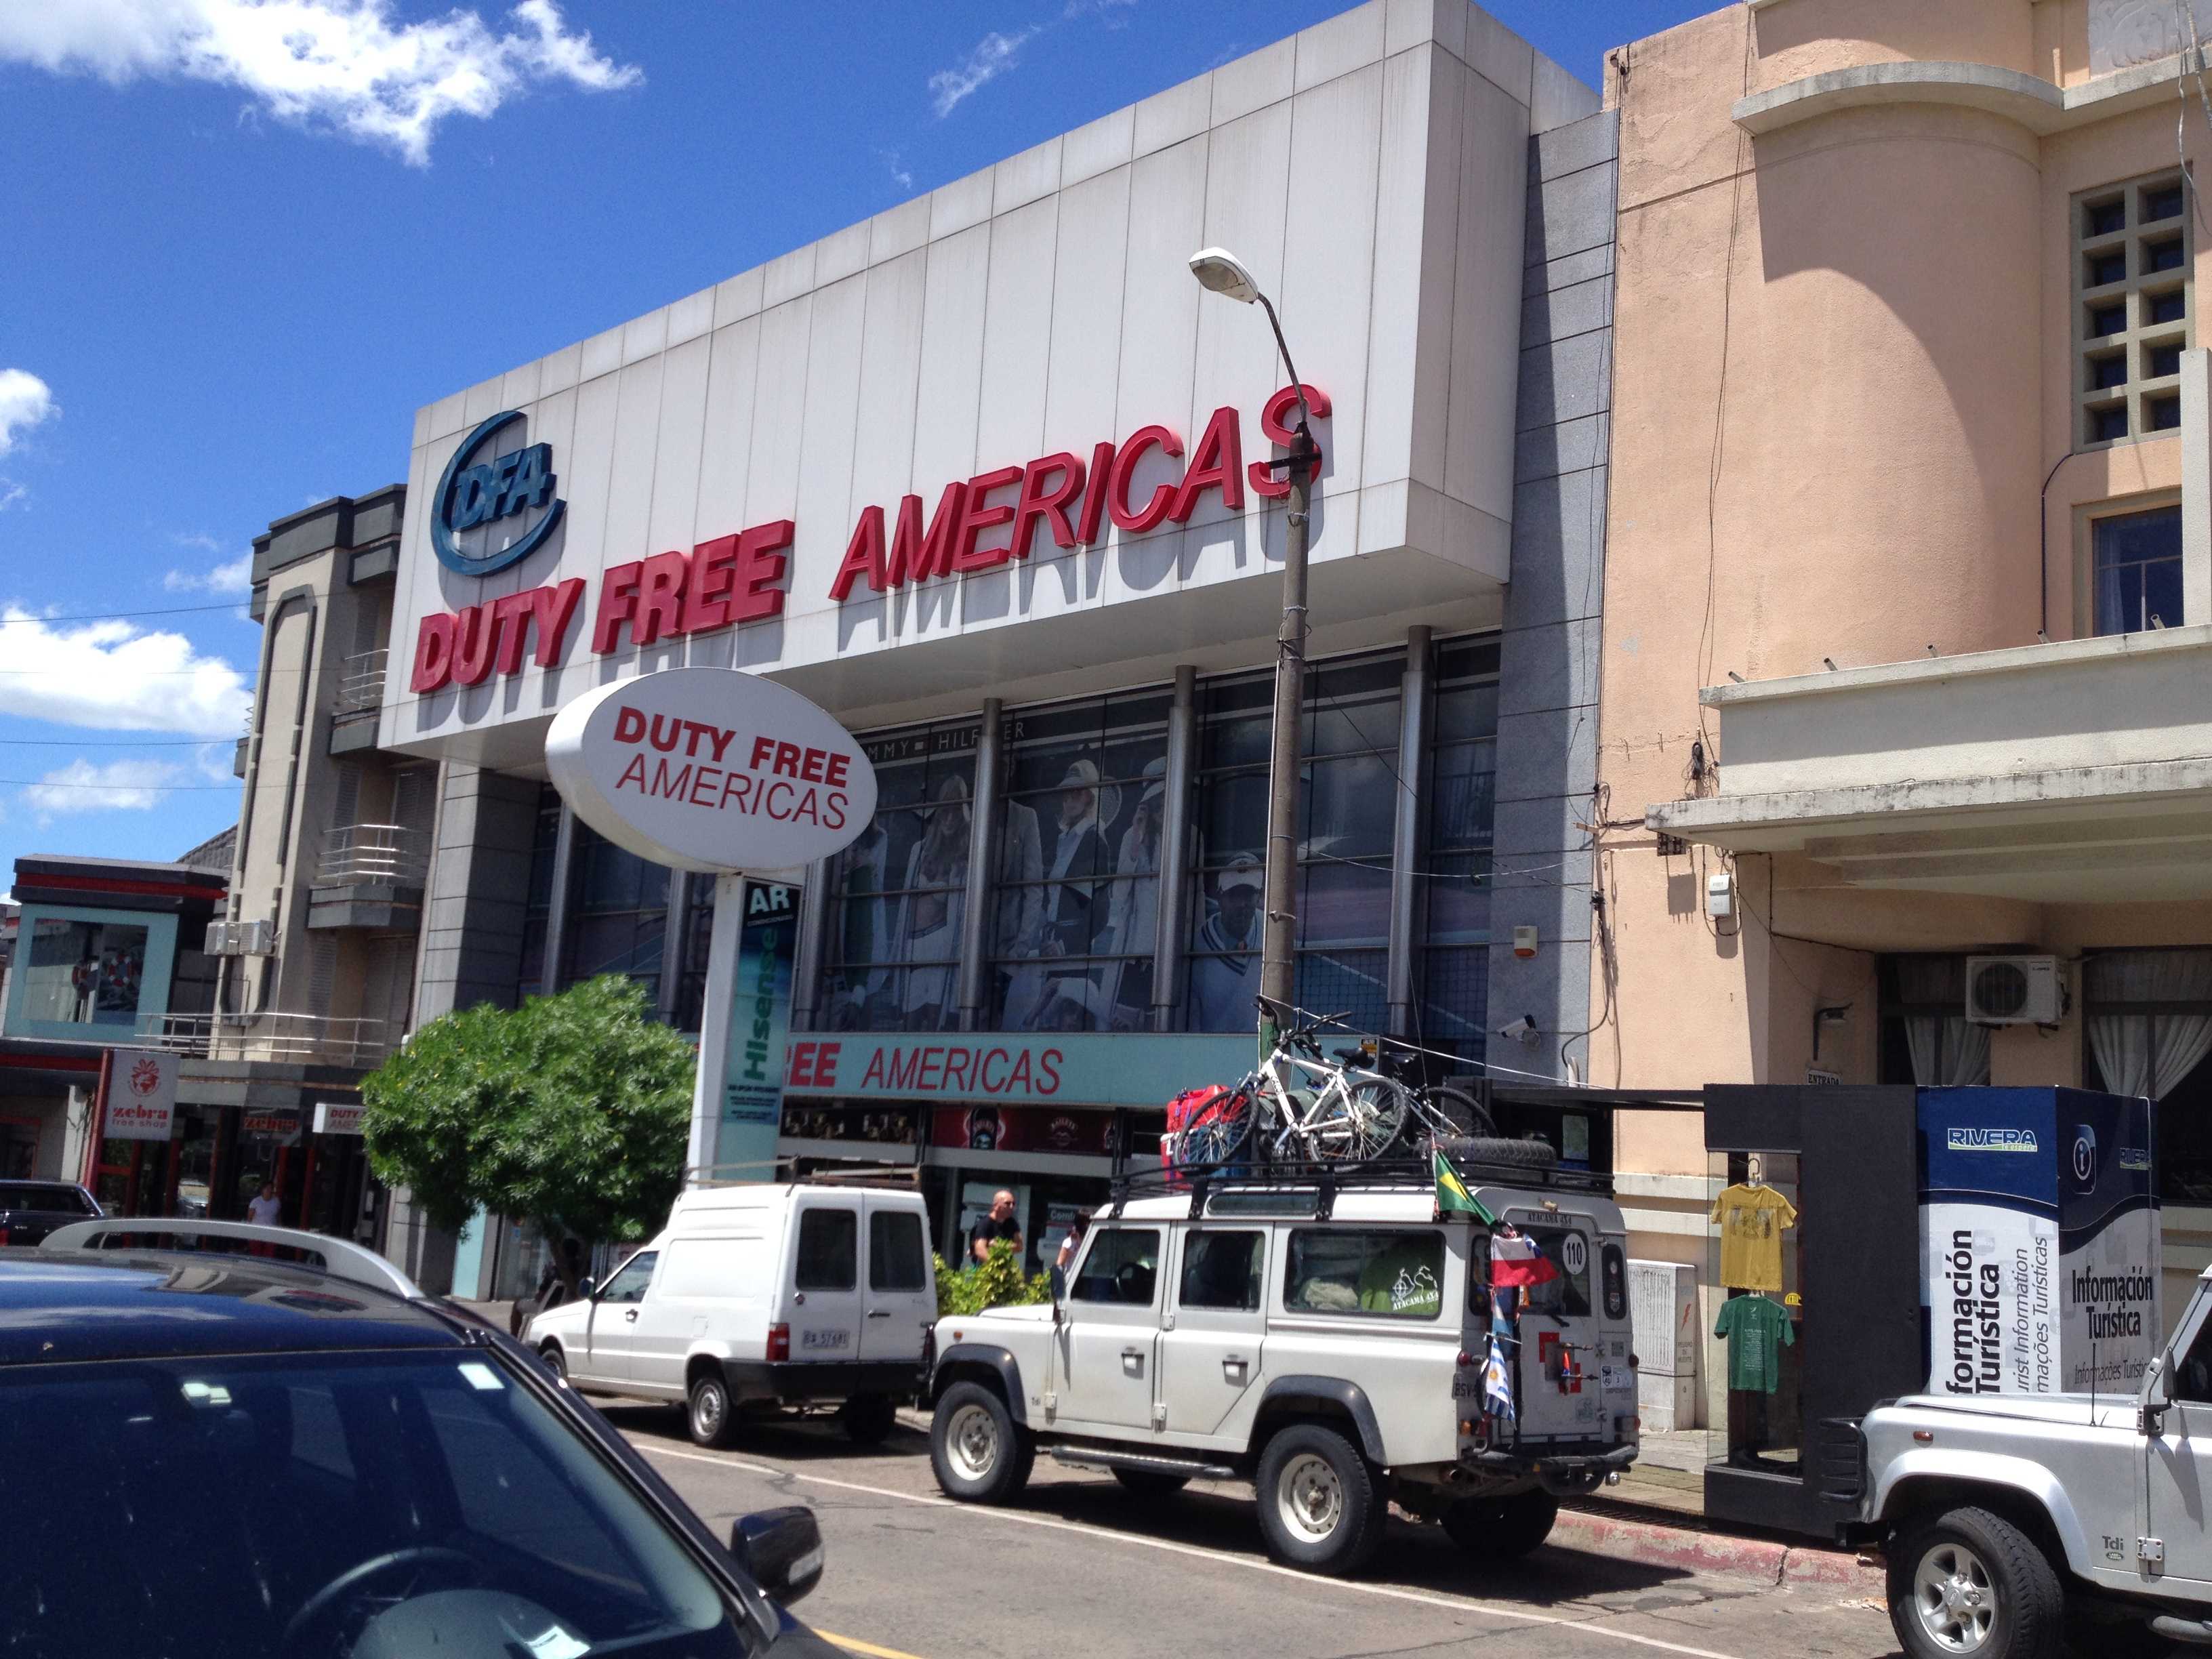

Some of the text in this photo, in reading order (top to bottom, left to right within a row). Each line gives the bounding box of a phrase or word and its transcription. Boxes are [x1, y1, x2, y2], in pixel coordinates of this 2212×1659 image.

[450, 443, 557, 532] DFA
[409, 384, 1332, 695] DUTY FREE AMERICAS
[613, 705, 851, 788] DUTY FREE
[867, 721, 1025, 760] MMY HILFER
[615, 753, 849, 830] AMERICAS
[749, 885, 790, 914] AR
[783, 1042, 1064, 1095] EE AMERICAS
[1807, 1073, 1839, 1084] ENTRADA
[113, 1104, 168, 1120] zebra
[243, 1115, 299, 1132] zebra
[330, 1109, 359, 1119] DUTY
[1948, 1128, 2037, 1147] RIVERA
[1566, 1242, 1582, 1265] 110
[2012, 1249, 2030, 1355] Information
[2072, 1265, 2152, 1303] Información
[1945, 1230, 1973, 1394] formación
[1973, 1264, 2001, 1394] Turística
[2031, 1237, 2053, 1393] mações Turísticas
[2086, 1302, 2141, 1339] Turística
[2074, 1361, 2121, 1386] Informações
[2102, 1536, 2124, 1551] Tdi
